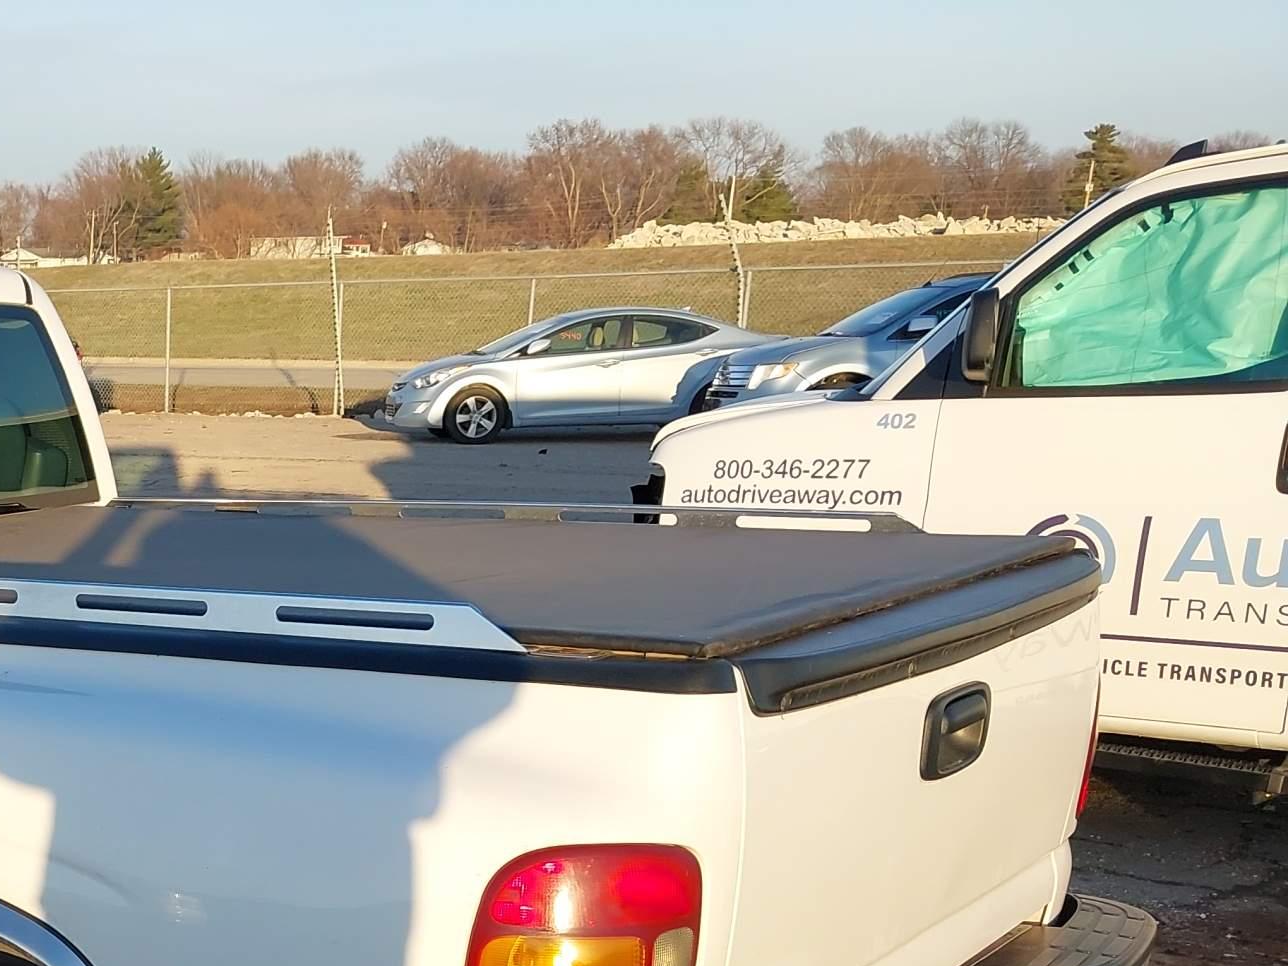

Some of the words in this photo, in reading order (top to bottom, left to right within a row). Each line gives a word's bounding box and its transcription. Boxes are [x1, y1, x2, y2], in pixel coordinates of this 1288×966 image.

[876, 413, 918, 429] 402
[713, 459, 871, 480] 800-346-2277
[680, 484, 903, 509] autodriveaway.com
